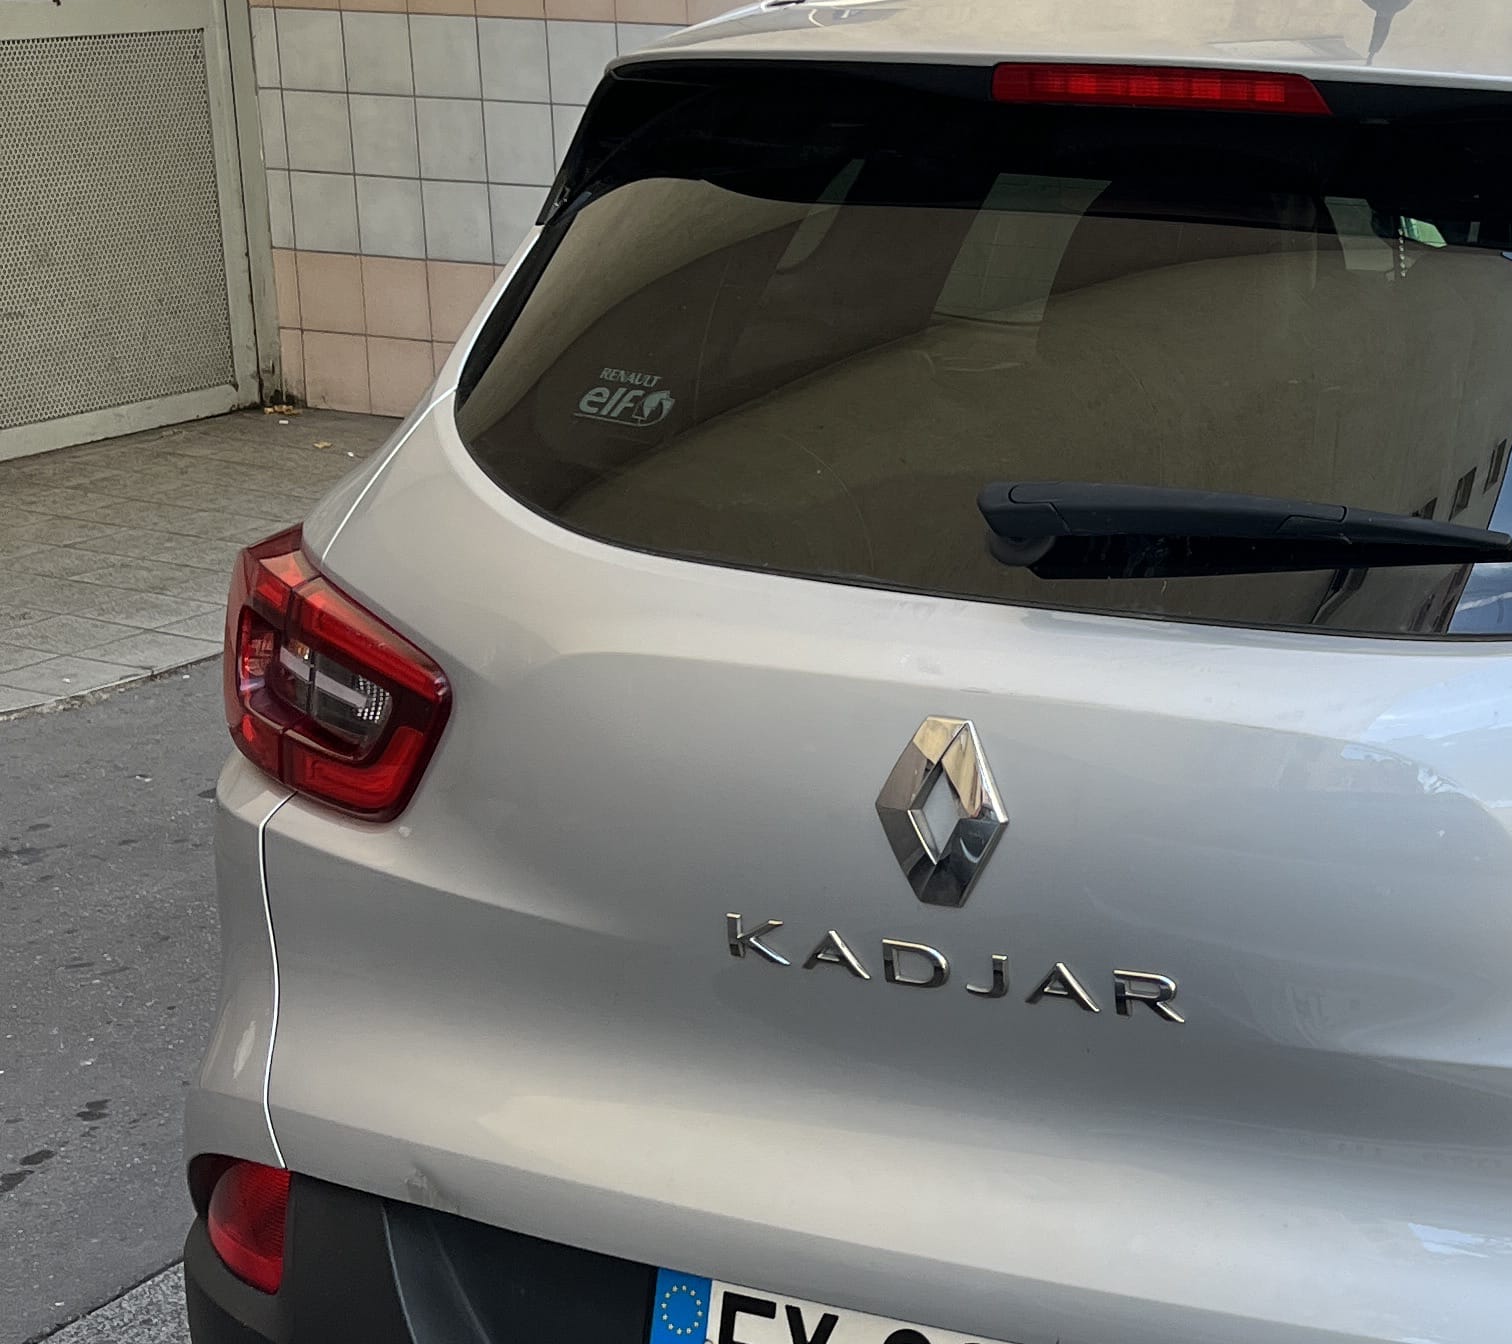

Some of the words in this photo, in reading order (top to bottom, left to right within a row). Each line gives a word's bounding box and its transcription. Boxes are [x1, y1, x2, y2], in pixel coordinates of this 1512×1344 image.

[600, 367, 662, 388] RENAULT
[579, 386, 646, 417] elf
[725, 912, 1186, 1024] KADJAR
